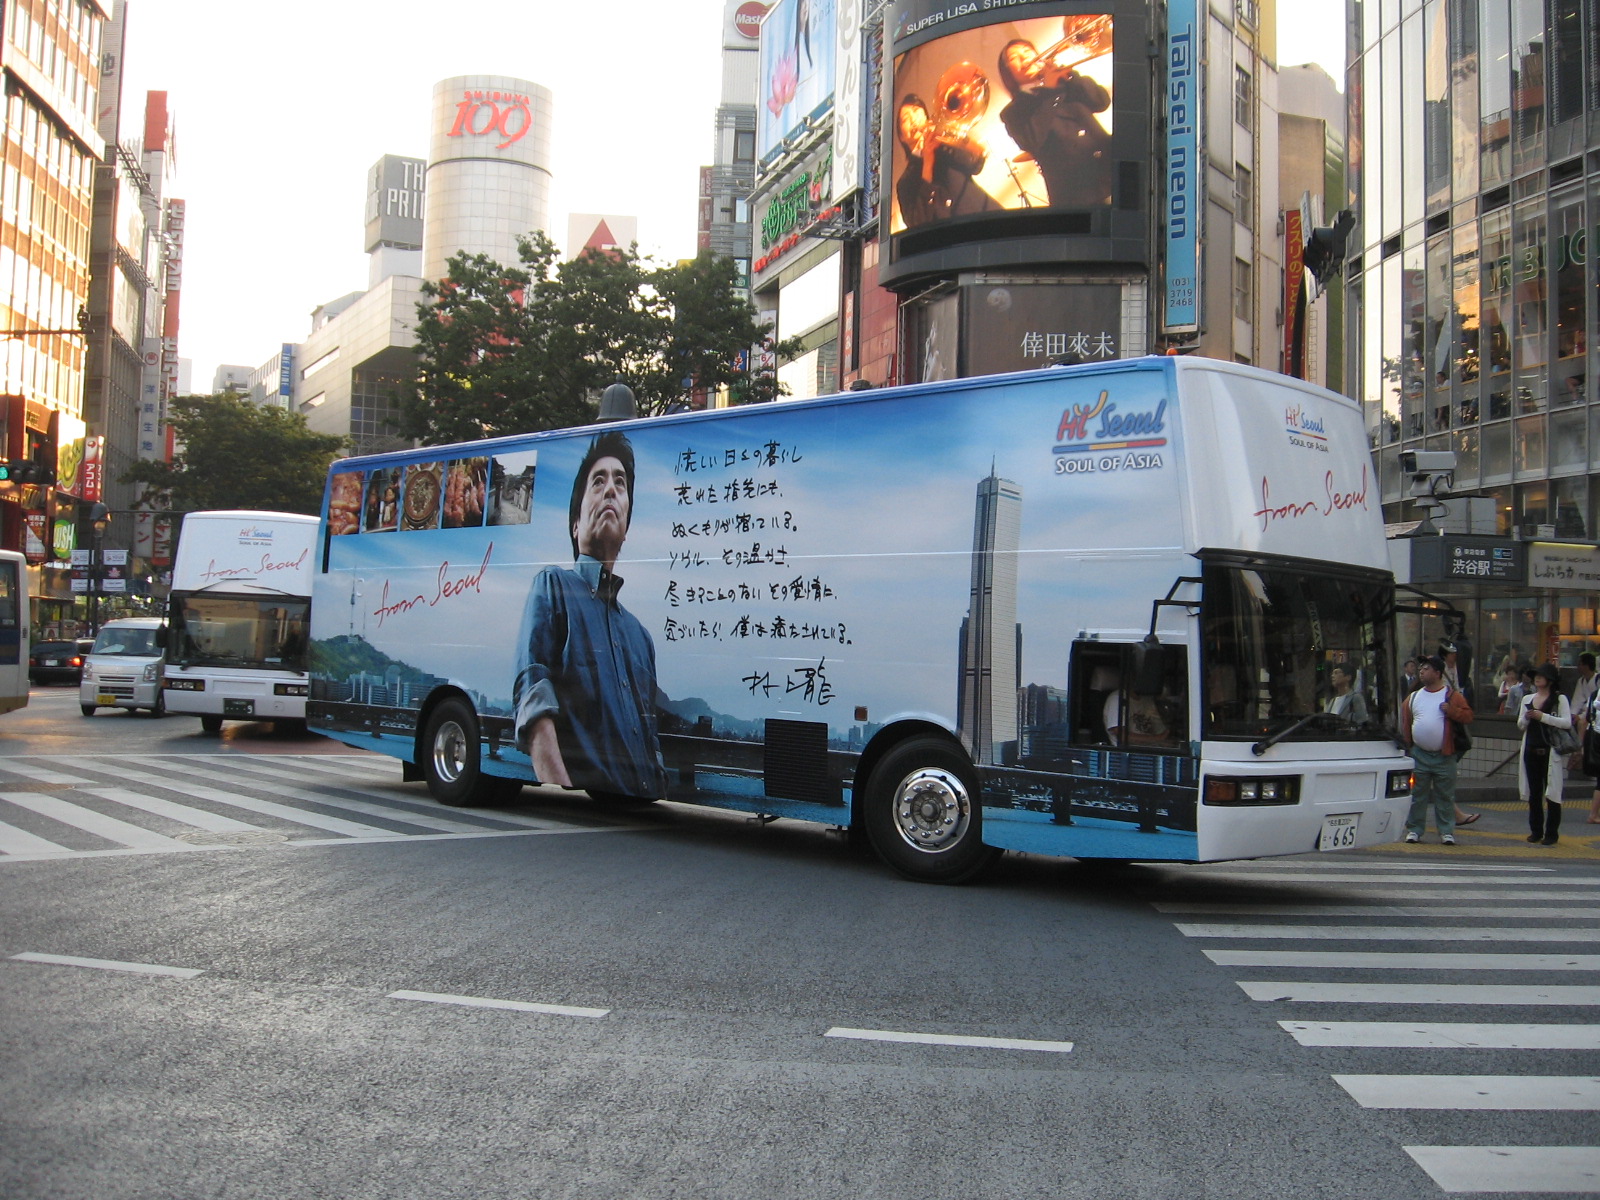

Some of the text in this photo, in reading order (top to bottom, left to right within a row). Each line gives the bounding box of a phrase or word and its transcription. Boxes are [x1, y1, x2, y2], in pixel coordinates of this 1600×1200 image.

[906, 12, 944, 35] SUPER
[947, 3, 978, 20] LISA
[463, 90, 531, 105] SHIBUYA
[447, 100, 533, 150] 109
[1170, 24, 1191, 240] Taisei neon
[402, 161, 426, 190] TH
[387, 188, 426, 220] PRI
[1170, 289, 1193, 298] 3719
[1171, 277, 1190, 287] (03)
[1169, 298, 1194, 308] 2468
[1020, 331, 1115, 358] 倖田來未
[1056, 396, 1168, 441] Hi Seoul
[1301, 412, 1325, 433] Seoul
[85, 463, 96, 488] アコム
[1055, 452, 1163, 474] SOUL OF ASIA
[1253, 463, 1368, 533] from Seoul
[252, 529, 274, 538] Seoul
[199, 548, 309, 582] from Seoul
[1452, 558, 1490, 576] 渋谷駅
[373, 541, 494, 628] from Seoul
[1333, 826, 1356, 847] 665
